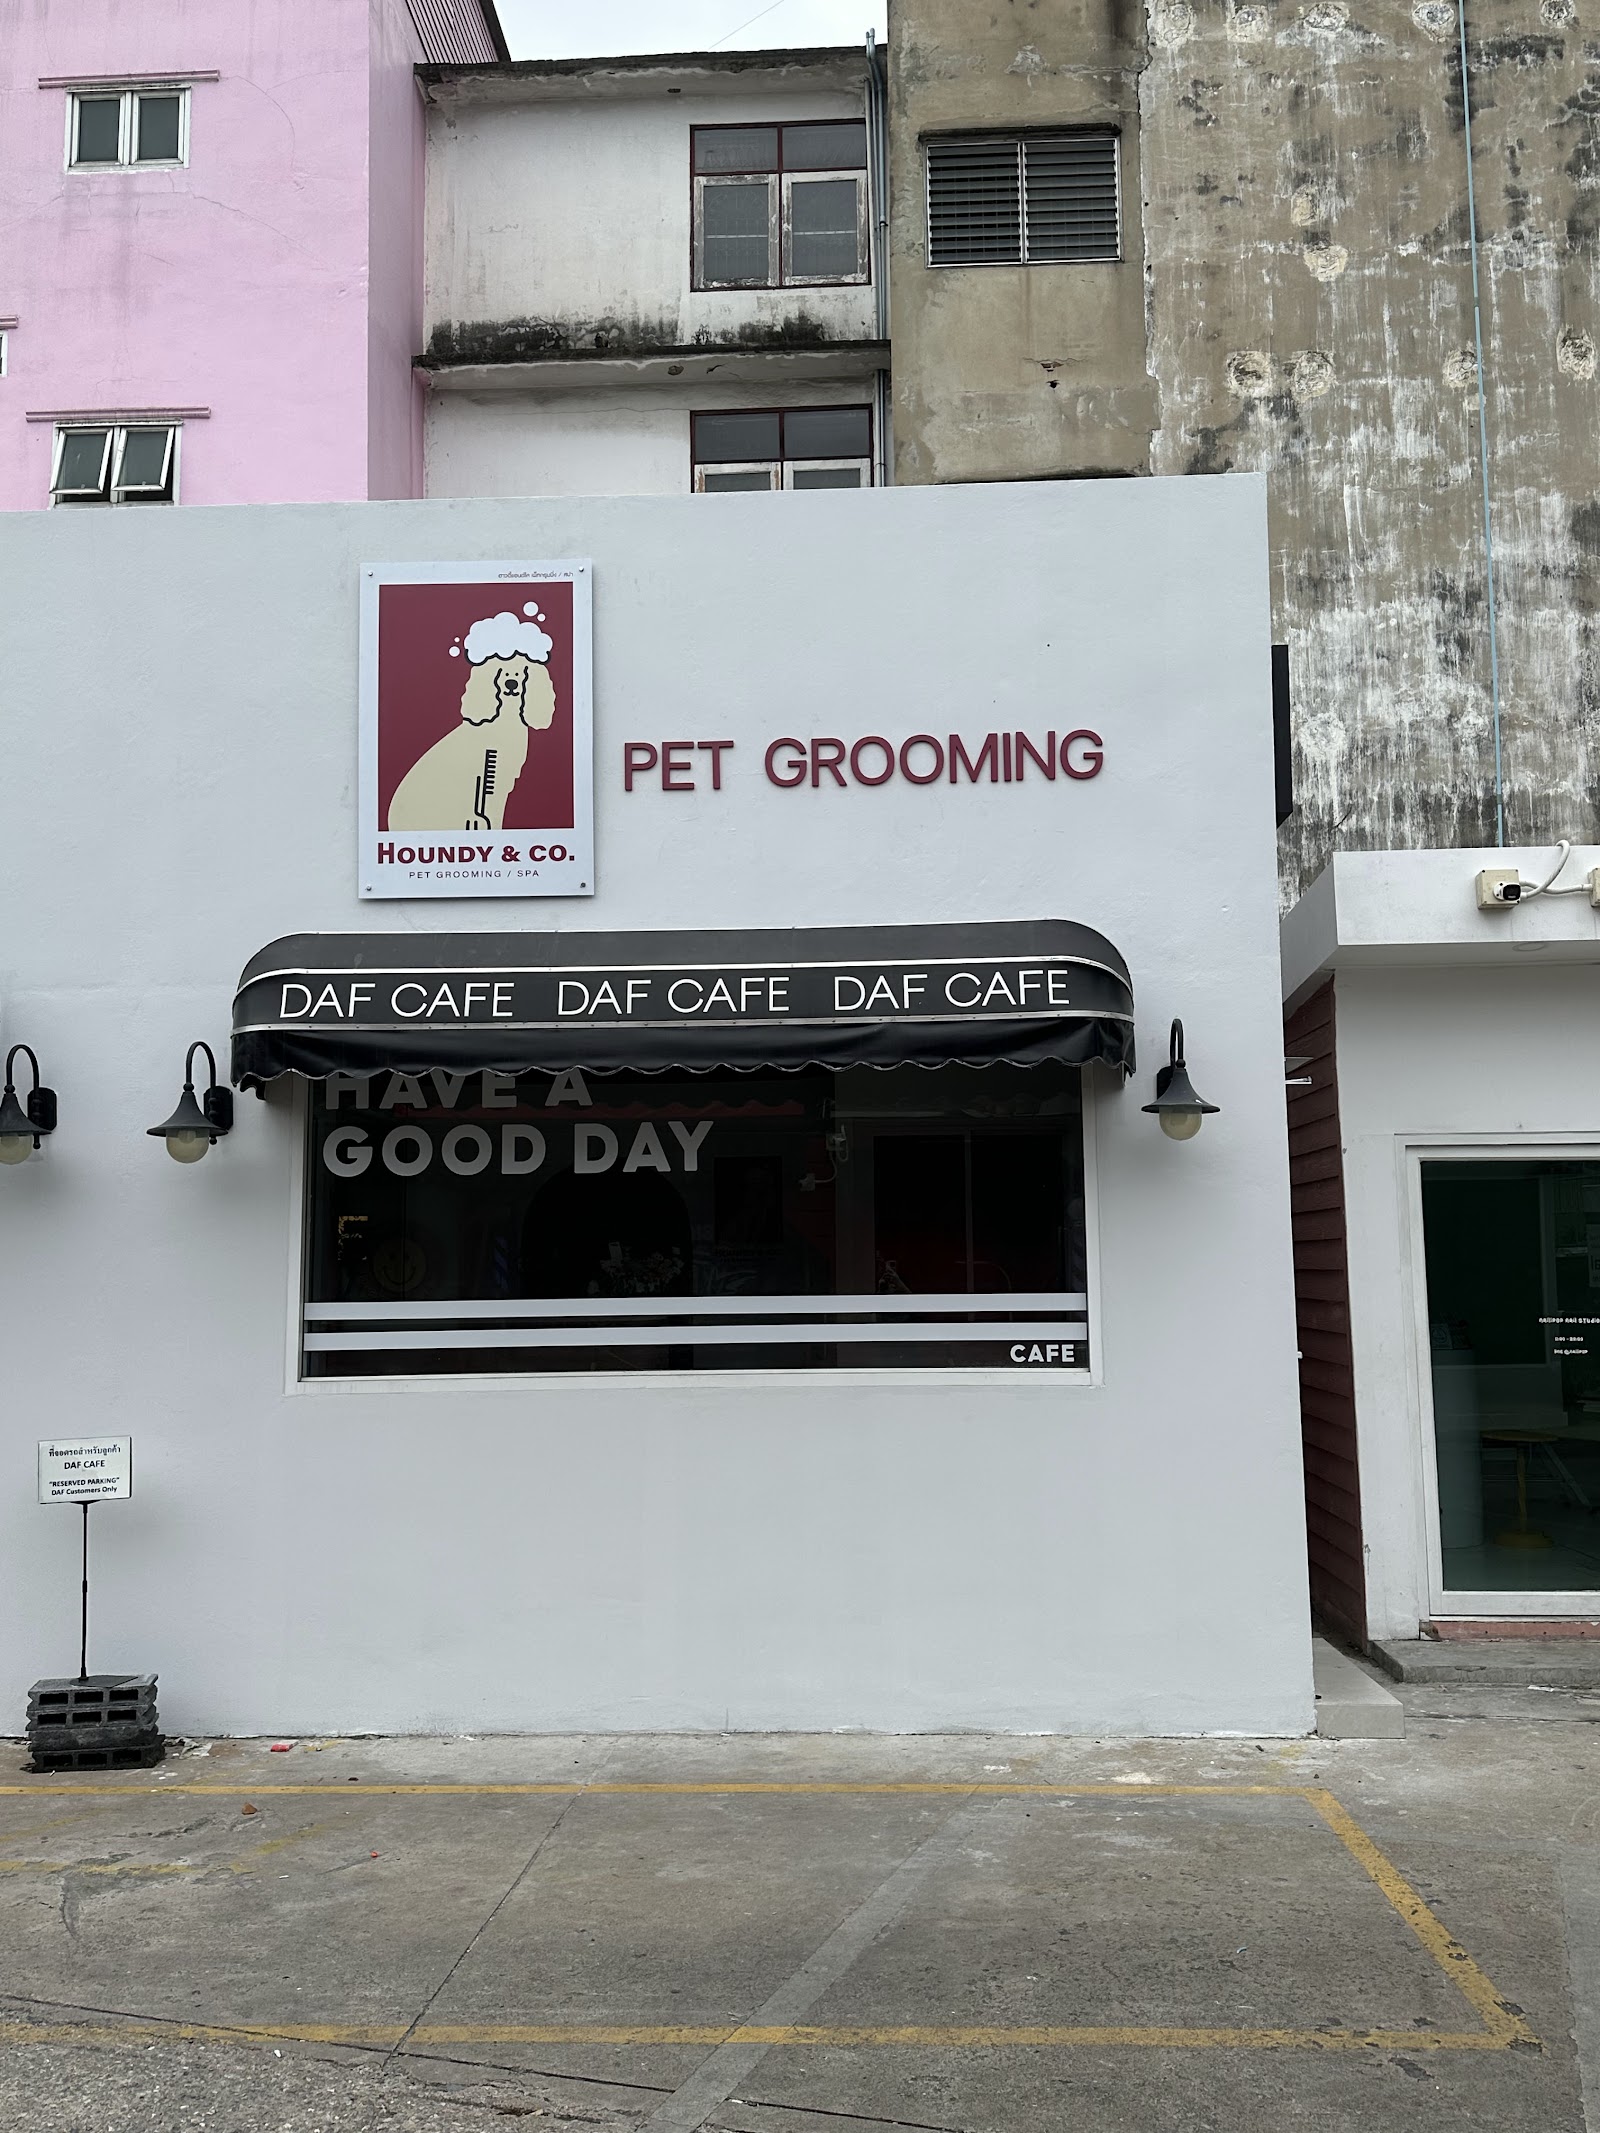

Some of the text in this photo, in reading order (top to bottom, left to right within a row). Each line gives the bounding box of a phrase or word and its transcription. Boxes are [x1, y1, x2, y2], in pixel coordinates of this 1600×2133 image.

[625, 729, 1104, 792] PET GROOMING
[377, 842, 575, 865] HOUNDY & CO.
[409, 871, 430, 879] PET
[436, 870, 502, 879] GROOMING
[517, 869, 540, 878] SPA
[279, 968, 1070, 1019] DAF CAFE DAF CAFE DAF CAFE
[325, 1067, 594, 1110] HAVE A
[322, 1120, 715, 1178] GOOD DAY
[1010, 1344, 1075, 1363] CAFE
[49, 1444, 121, 1457] ที่จอดรถสำหรับลูกค้า
[64, 1459, 106, 1470] DAF CAFE
[51, 1485, 118, 1496] DAF Customers Only
